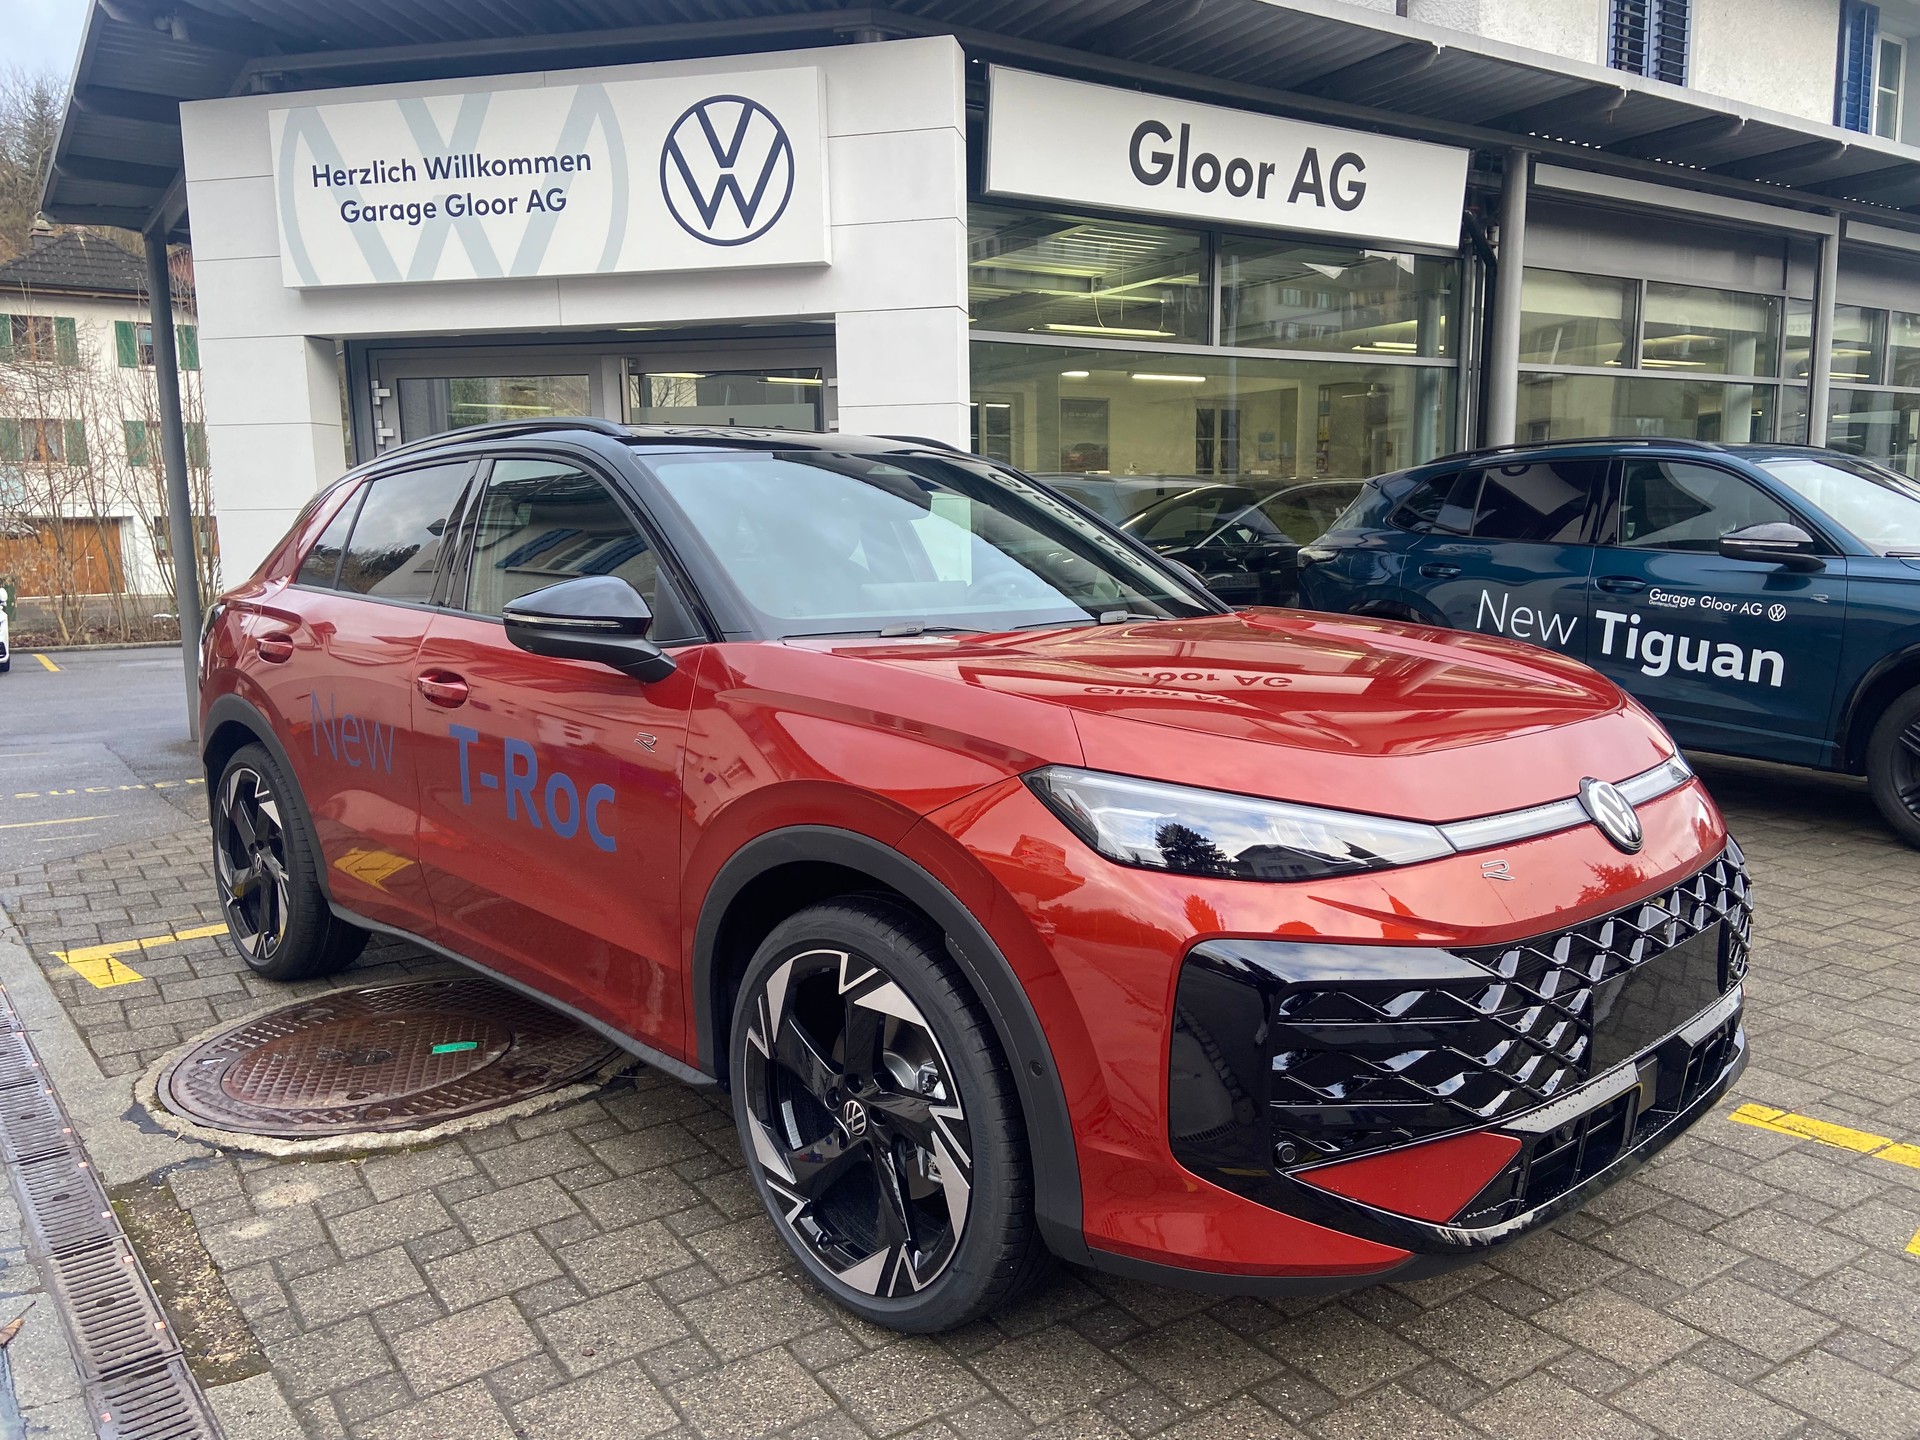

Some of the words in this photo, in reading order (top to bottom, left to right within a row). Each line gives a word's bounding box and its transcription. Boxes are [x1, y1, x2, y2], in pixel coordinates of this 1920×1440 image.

[312, 159, 417, 188] Herzlich
[423, 153, 591, 181] Willkommen
[1129, 119, 1276, 200] Gloor
[1287, 146, 1367, 212] AG
[340, 201, 437, 226] Garage
[445, 193, 518, 218] Gloor
[526, 188, 567, 212] AG
[1649, 588, 1696, 608] Garage
[1700, 595, 1738, 612] Gloor
[1739, 601, 1763, 616] AG
[1476, 589, 1578, 645] New
[1595, 609, 1785, 687] Tiguan
[310, 689, 396, 775] New
[449, 723, 617, 853] T-Roc
